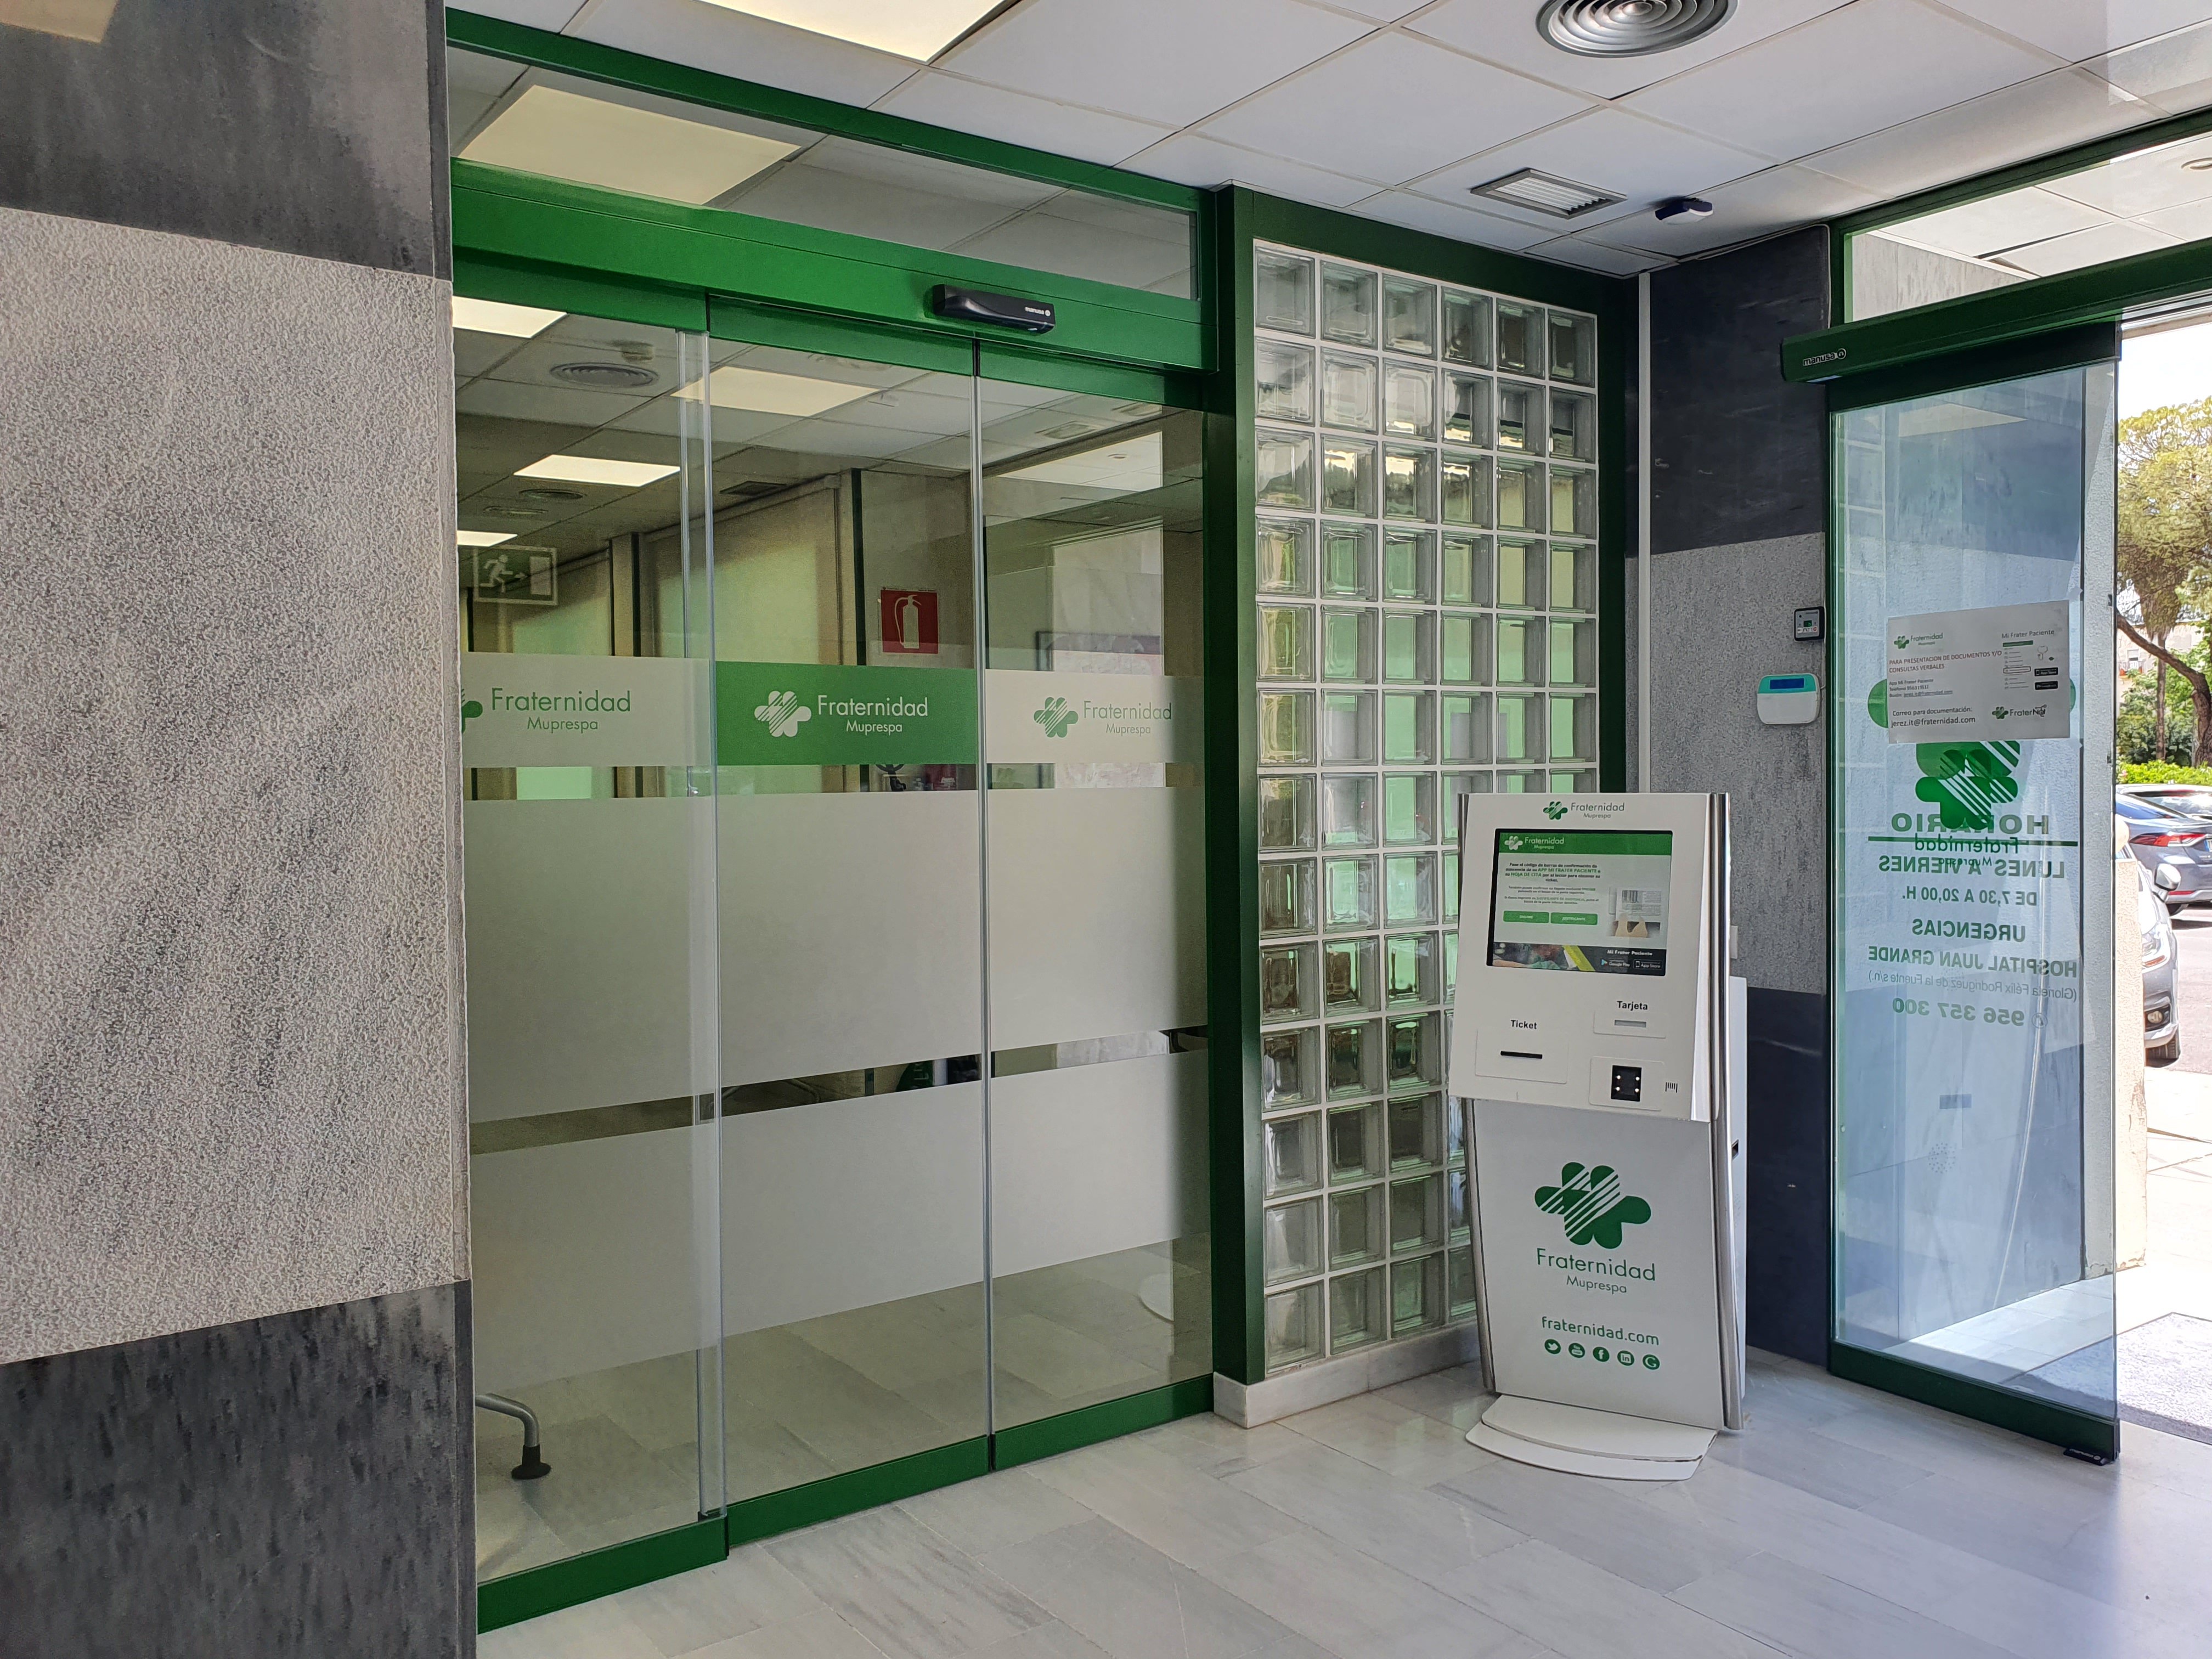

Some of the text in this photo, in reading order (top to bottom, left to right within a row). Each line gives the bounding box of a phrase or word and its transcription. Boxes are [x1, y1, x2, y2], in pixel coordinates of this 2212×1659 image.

[1803, 352, 1836, 366] manusa
[1910, 633, 1943, 642] Fraternidad
[1951, 651, 1990, 660] DOCUMENTOS
[492, 687, 631, 712] Fraternidad
[817, 695, 928, 716] Fraternidad
[1084, 700, 1172, 720] Fraternidad
[527, 716, 599, 734] Muprespa
[846, 719, 902, 736] Muprespa
[1891, 716, 1976, 728] jerez.it@fraternidad.com
[1105, 723, 1152, 736] Muprespa
[1571, 802, 1625, 811] Fraternidad
[1525, 837, 1564, 845] Fraternidad
[1616, 1001, 1648, 1011] Tarjeta
[1510, 1020, 1537, 1029] Ticket
[1537, 1248, 1655, 1281] Fraternidad
[1566, 1275, 1627, 1295] Muprespa
[1542, 1316, 1659, 1346] fraternidad.com
